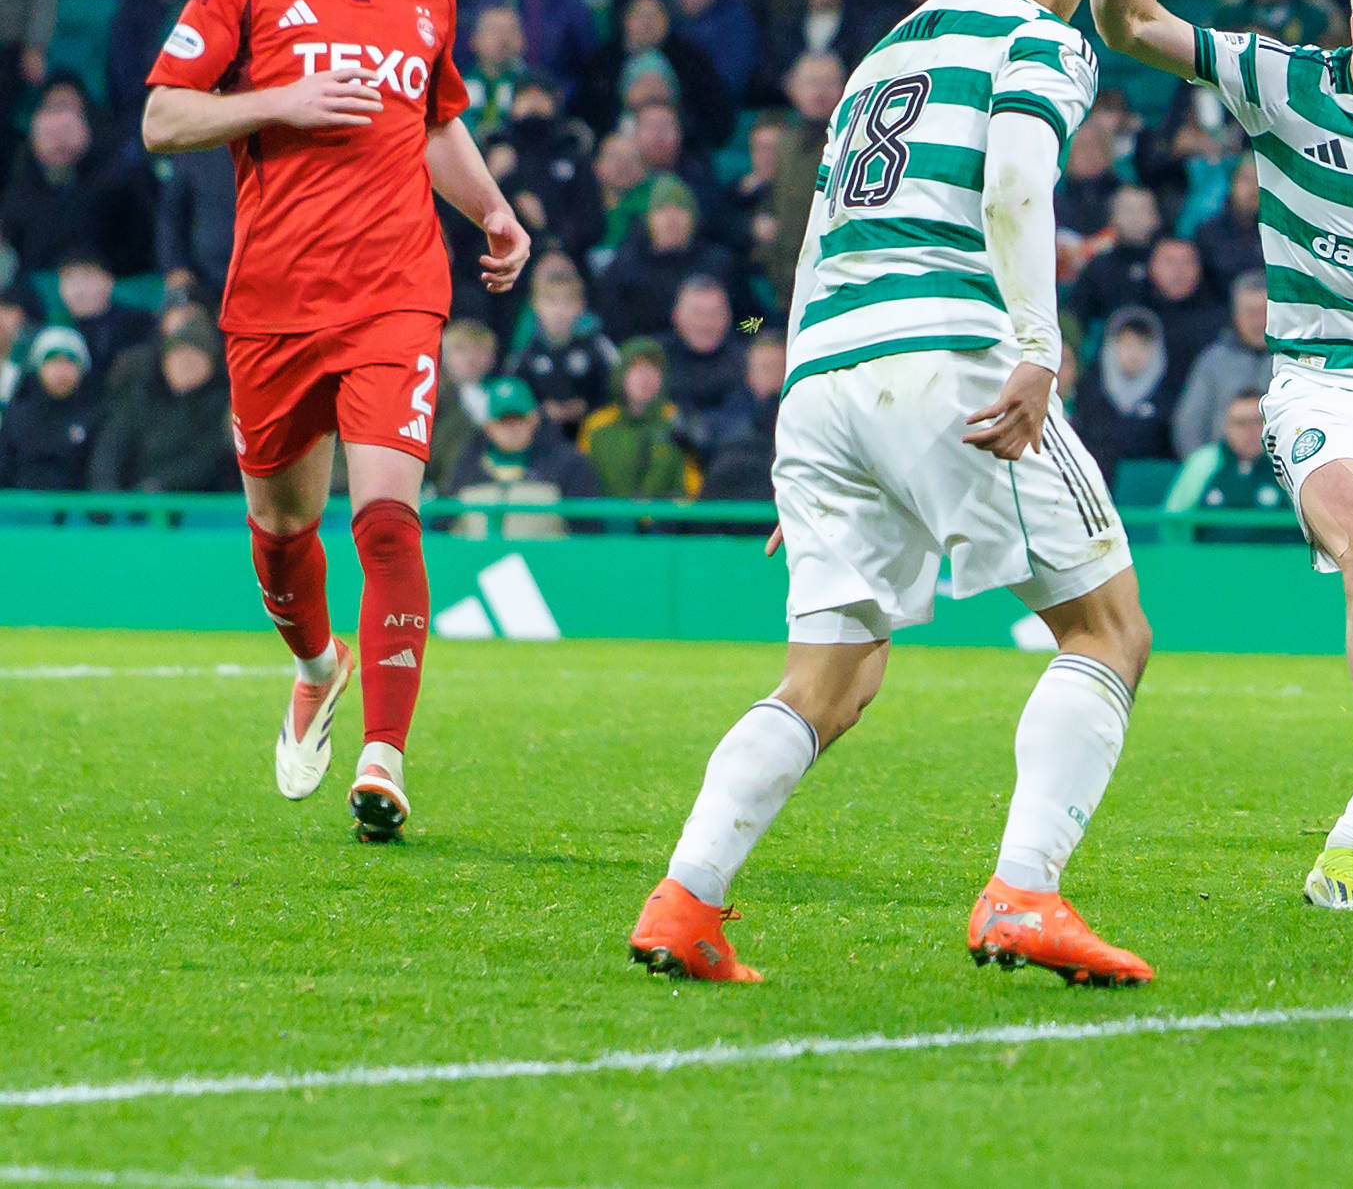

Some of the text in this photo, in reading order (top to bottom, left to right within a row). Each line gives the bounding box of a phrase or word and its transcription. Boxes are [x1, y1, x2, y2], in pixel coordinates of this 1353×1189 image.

[293, 42, 428, 100] TEXO
[829, 71, 931, 219] 18
[410, 354, 436, 415] 2
[383, 613, 425, 629] AFC
